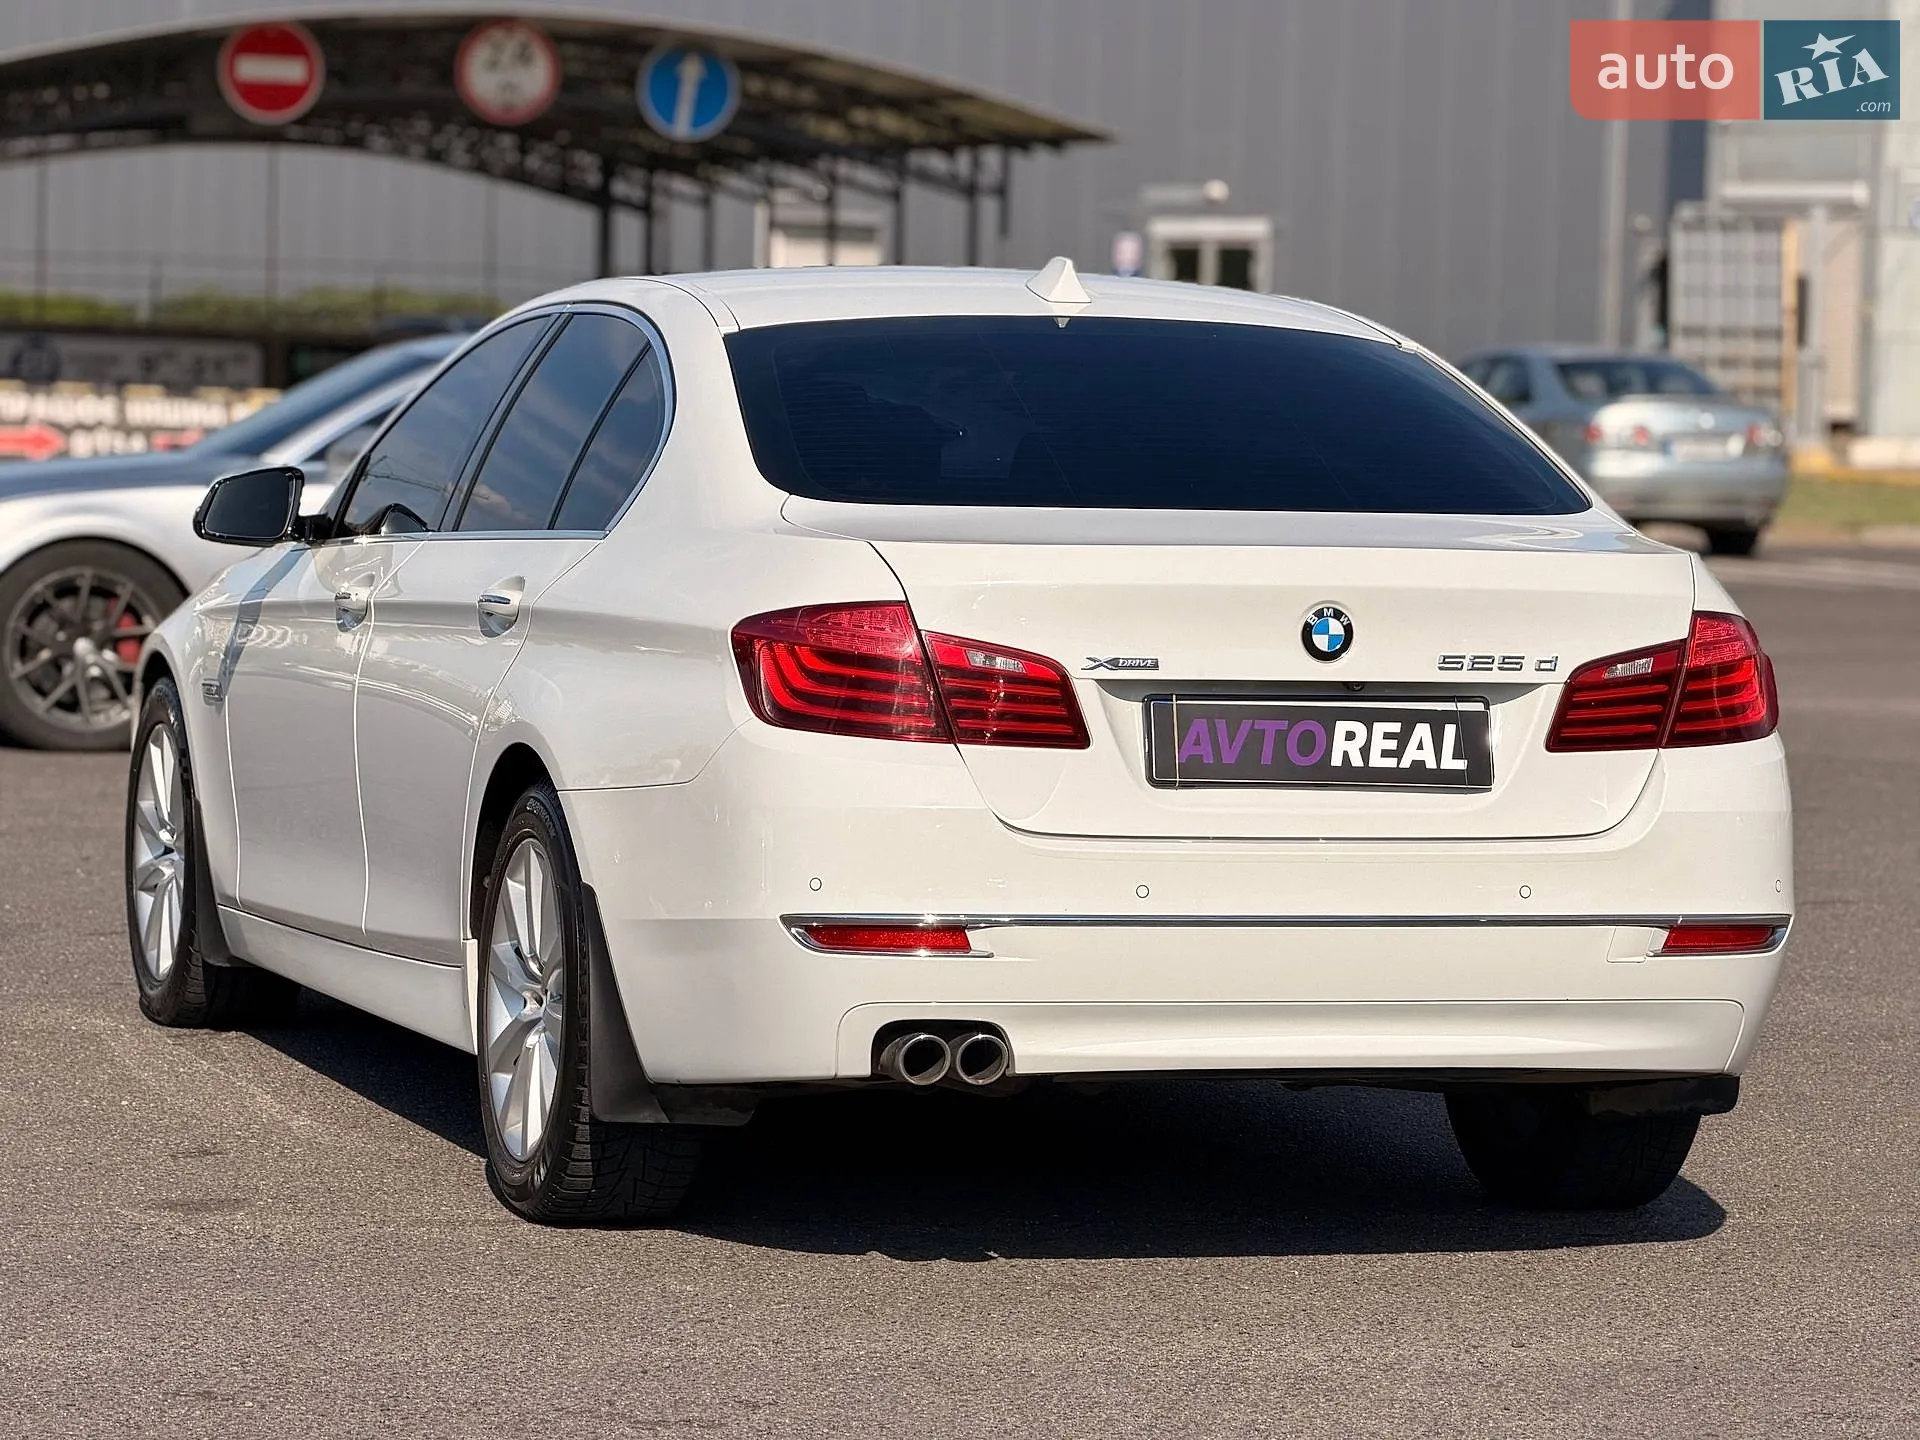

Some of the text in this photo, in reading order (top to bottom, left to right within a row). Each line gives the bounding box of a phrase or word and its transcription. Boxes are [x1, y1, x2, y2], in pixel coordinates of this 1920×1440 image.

[1306, 608, 1351, 626] BMW
[1437, 655, 1559, 671] 525 d
[1178, 719, 1468, 770] AVTOREAL
